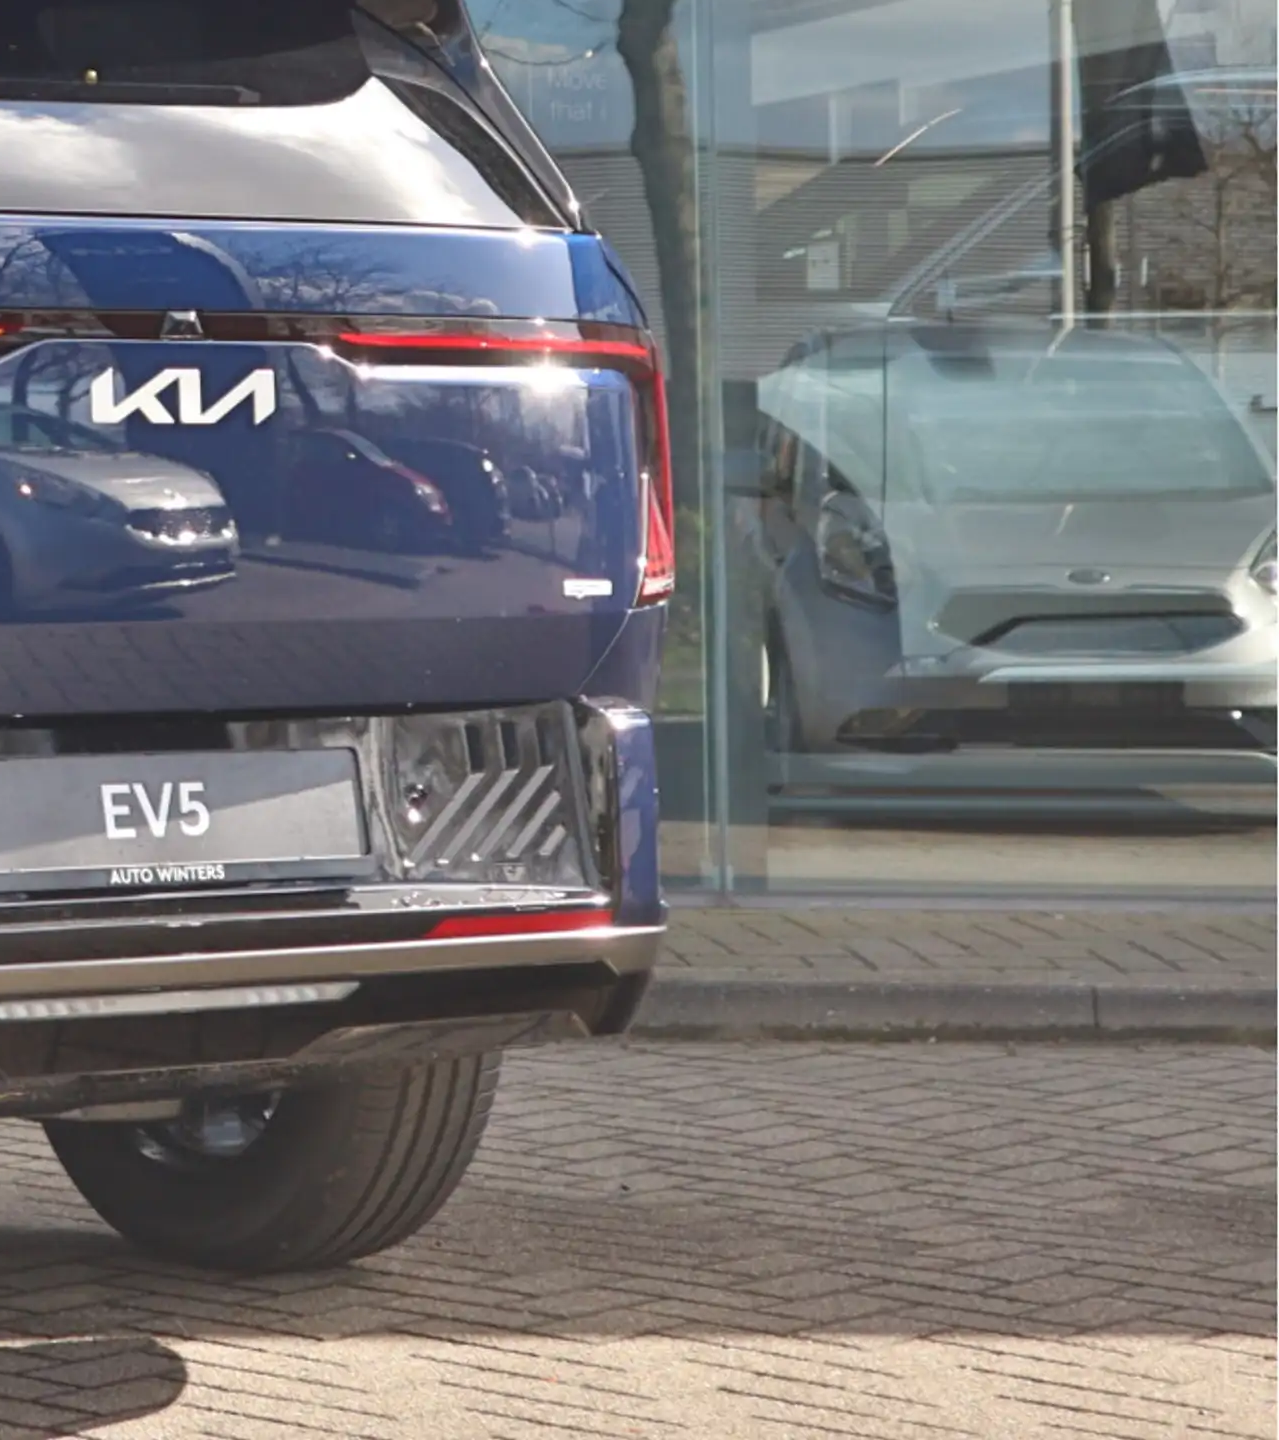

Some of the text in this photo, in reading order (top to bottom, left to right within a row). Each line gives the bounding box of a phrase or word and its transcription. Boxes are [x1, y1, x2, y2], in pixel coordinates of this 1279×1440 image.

[90, 367, 276, 426] KIA
[100, 782, 211, 840] EV5
[110, 864, 225, 885] AUTO WINTERS
